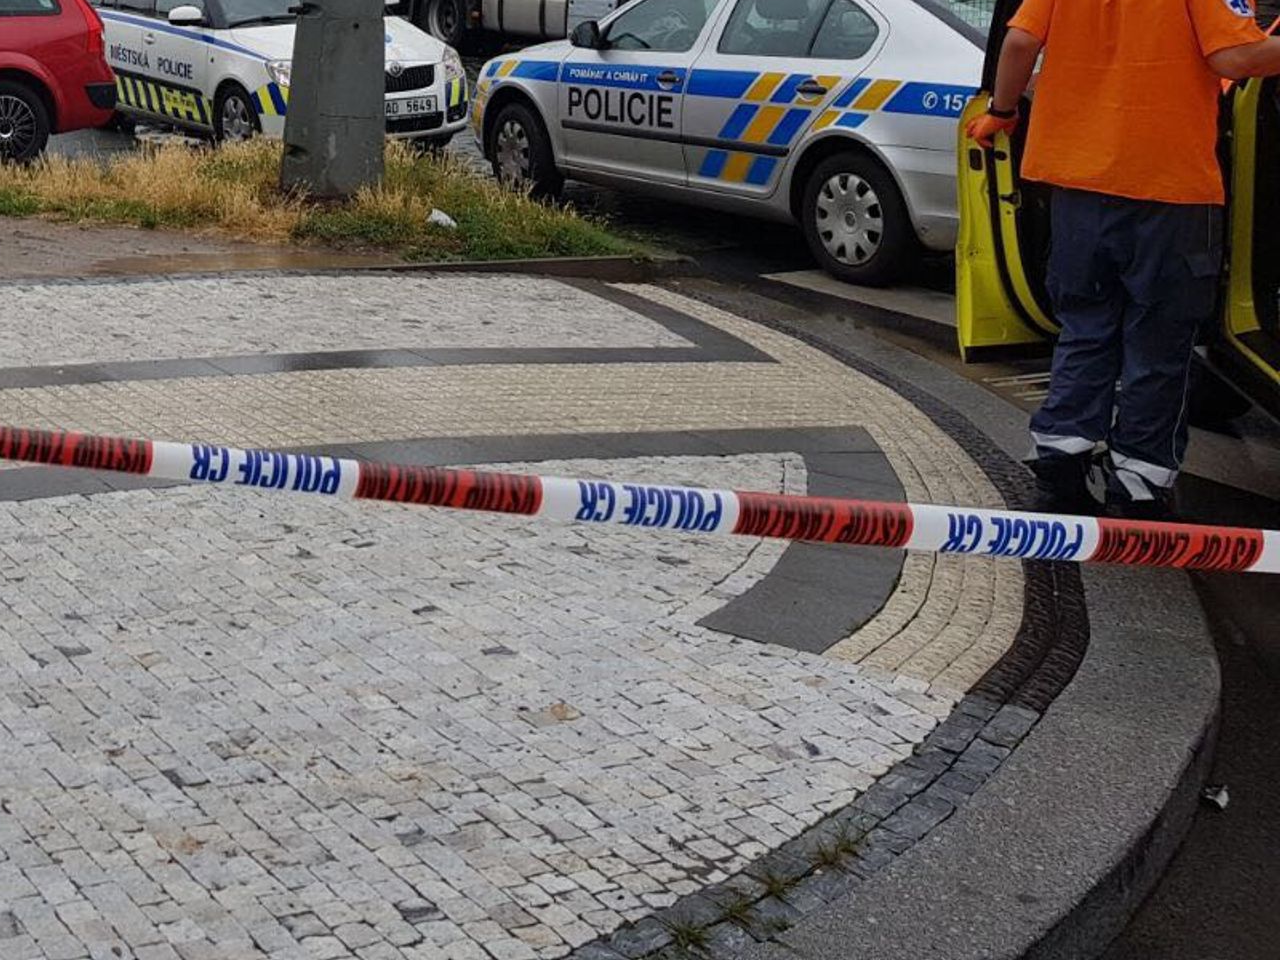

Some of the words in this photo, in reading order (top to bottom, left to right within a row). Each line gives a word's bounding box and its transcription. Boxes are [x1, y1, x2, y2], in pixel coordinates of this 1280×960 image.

[110, 43, 150, 69] MĚSTSKÁ
[158, 57, 193, 80] POLICIE
[606, 71, 612, 80] A
[406, 99, 432, 112] 5649
[568, 86, 674, 129] POLICIE
[943, 94, 972, 112] 15
[234, 447, 342, 496] POLICIE
[620, 484, 723, 533] POLICIE
[987, 516, 1084, 560] POLICIE
